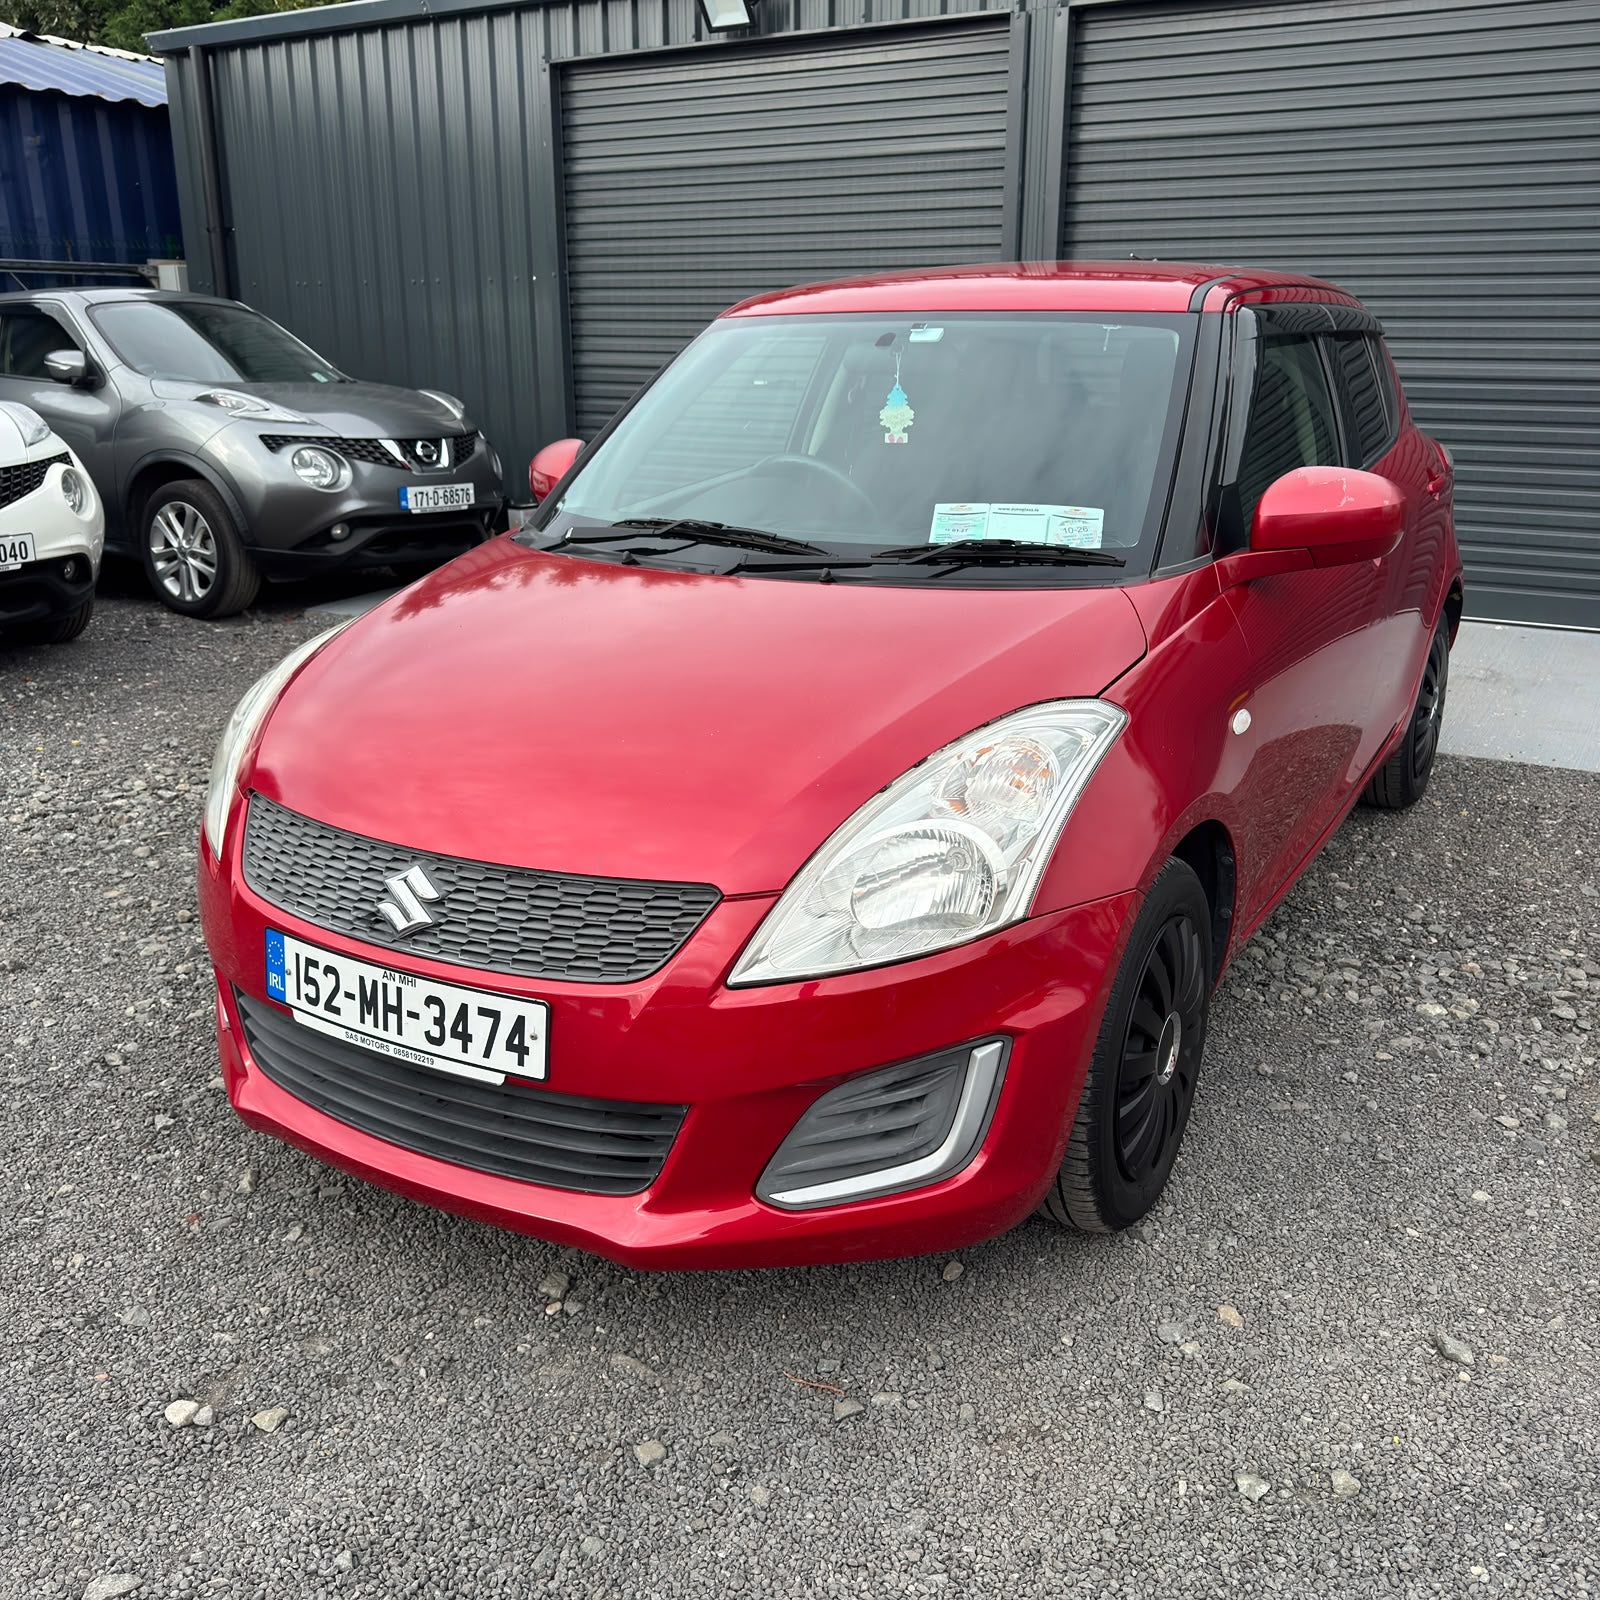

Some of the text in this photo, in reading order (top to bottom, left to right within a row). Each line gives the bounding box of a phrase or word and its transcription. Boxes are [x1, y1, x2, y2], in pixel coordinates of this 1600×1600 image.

[414, 488, 470, 507] 171-D-68576
[1063, 525, 1089, 534] 10-26
[269, 971, 285, 992] IRL
[382, 970, 417, 988] AN MHI
[294, 952, 530, 1067] 152-MH-3474
[345, 1031, 435, 1066] SAS MOTORS 0858192219
